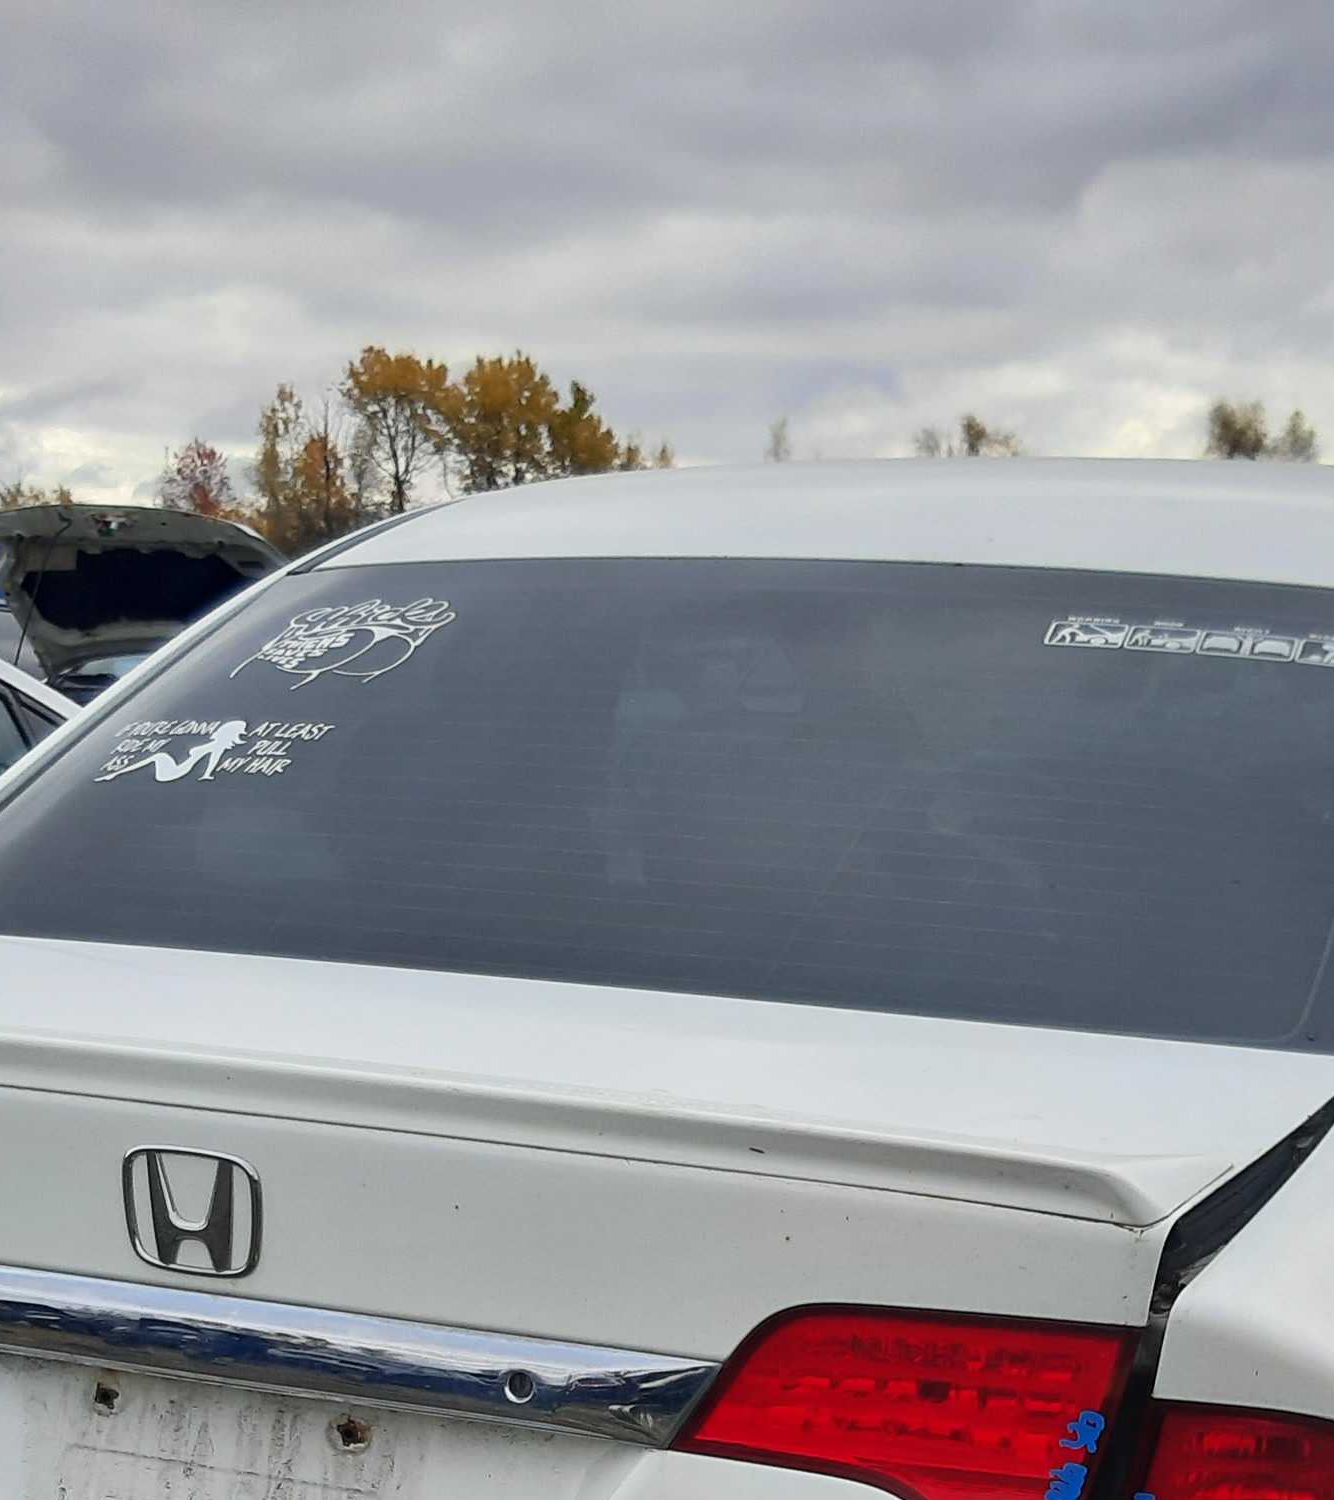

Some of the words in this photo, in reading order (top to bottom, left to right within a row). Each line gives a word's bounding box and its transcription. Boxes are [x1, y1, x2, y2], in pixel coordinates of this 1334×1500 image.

[247, 721, 282, 737] AT
[274, 723, 336, 740] LEAST
[247, 740, 292, 756] PULL
[100, 755, 135, 771] ASS
[215, 757, 252, 773] MY
[243, 757, 292, 776] HAIR
